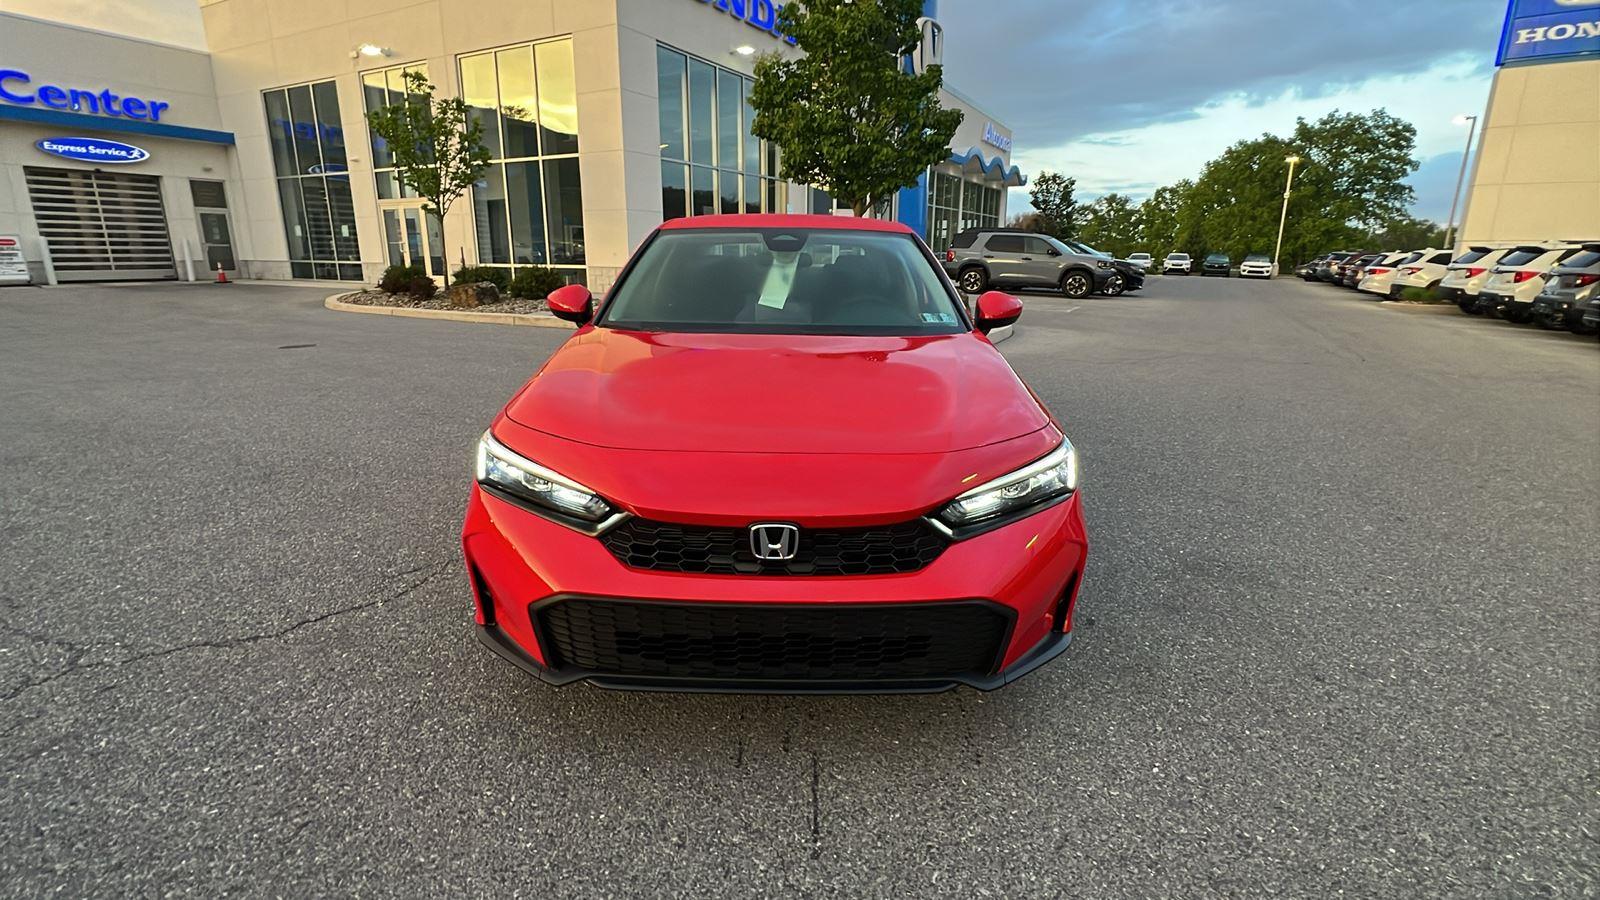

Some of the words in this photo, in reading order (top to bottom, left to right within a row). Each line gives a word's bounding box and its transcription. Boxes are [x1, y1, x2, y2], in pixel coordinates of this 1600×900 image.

[0, 69, 169, 121] Center
[43, 141, 87, 153] Express
[88, 145, 128, 157] Service
